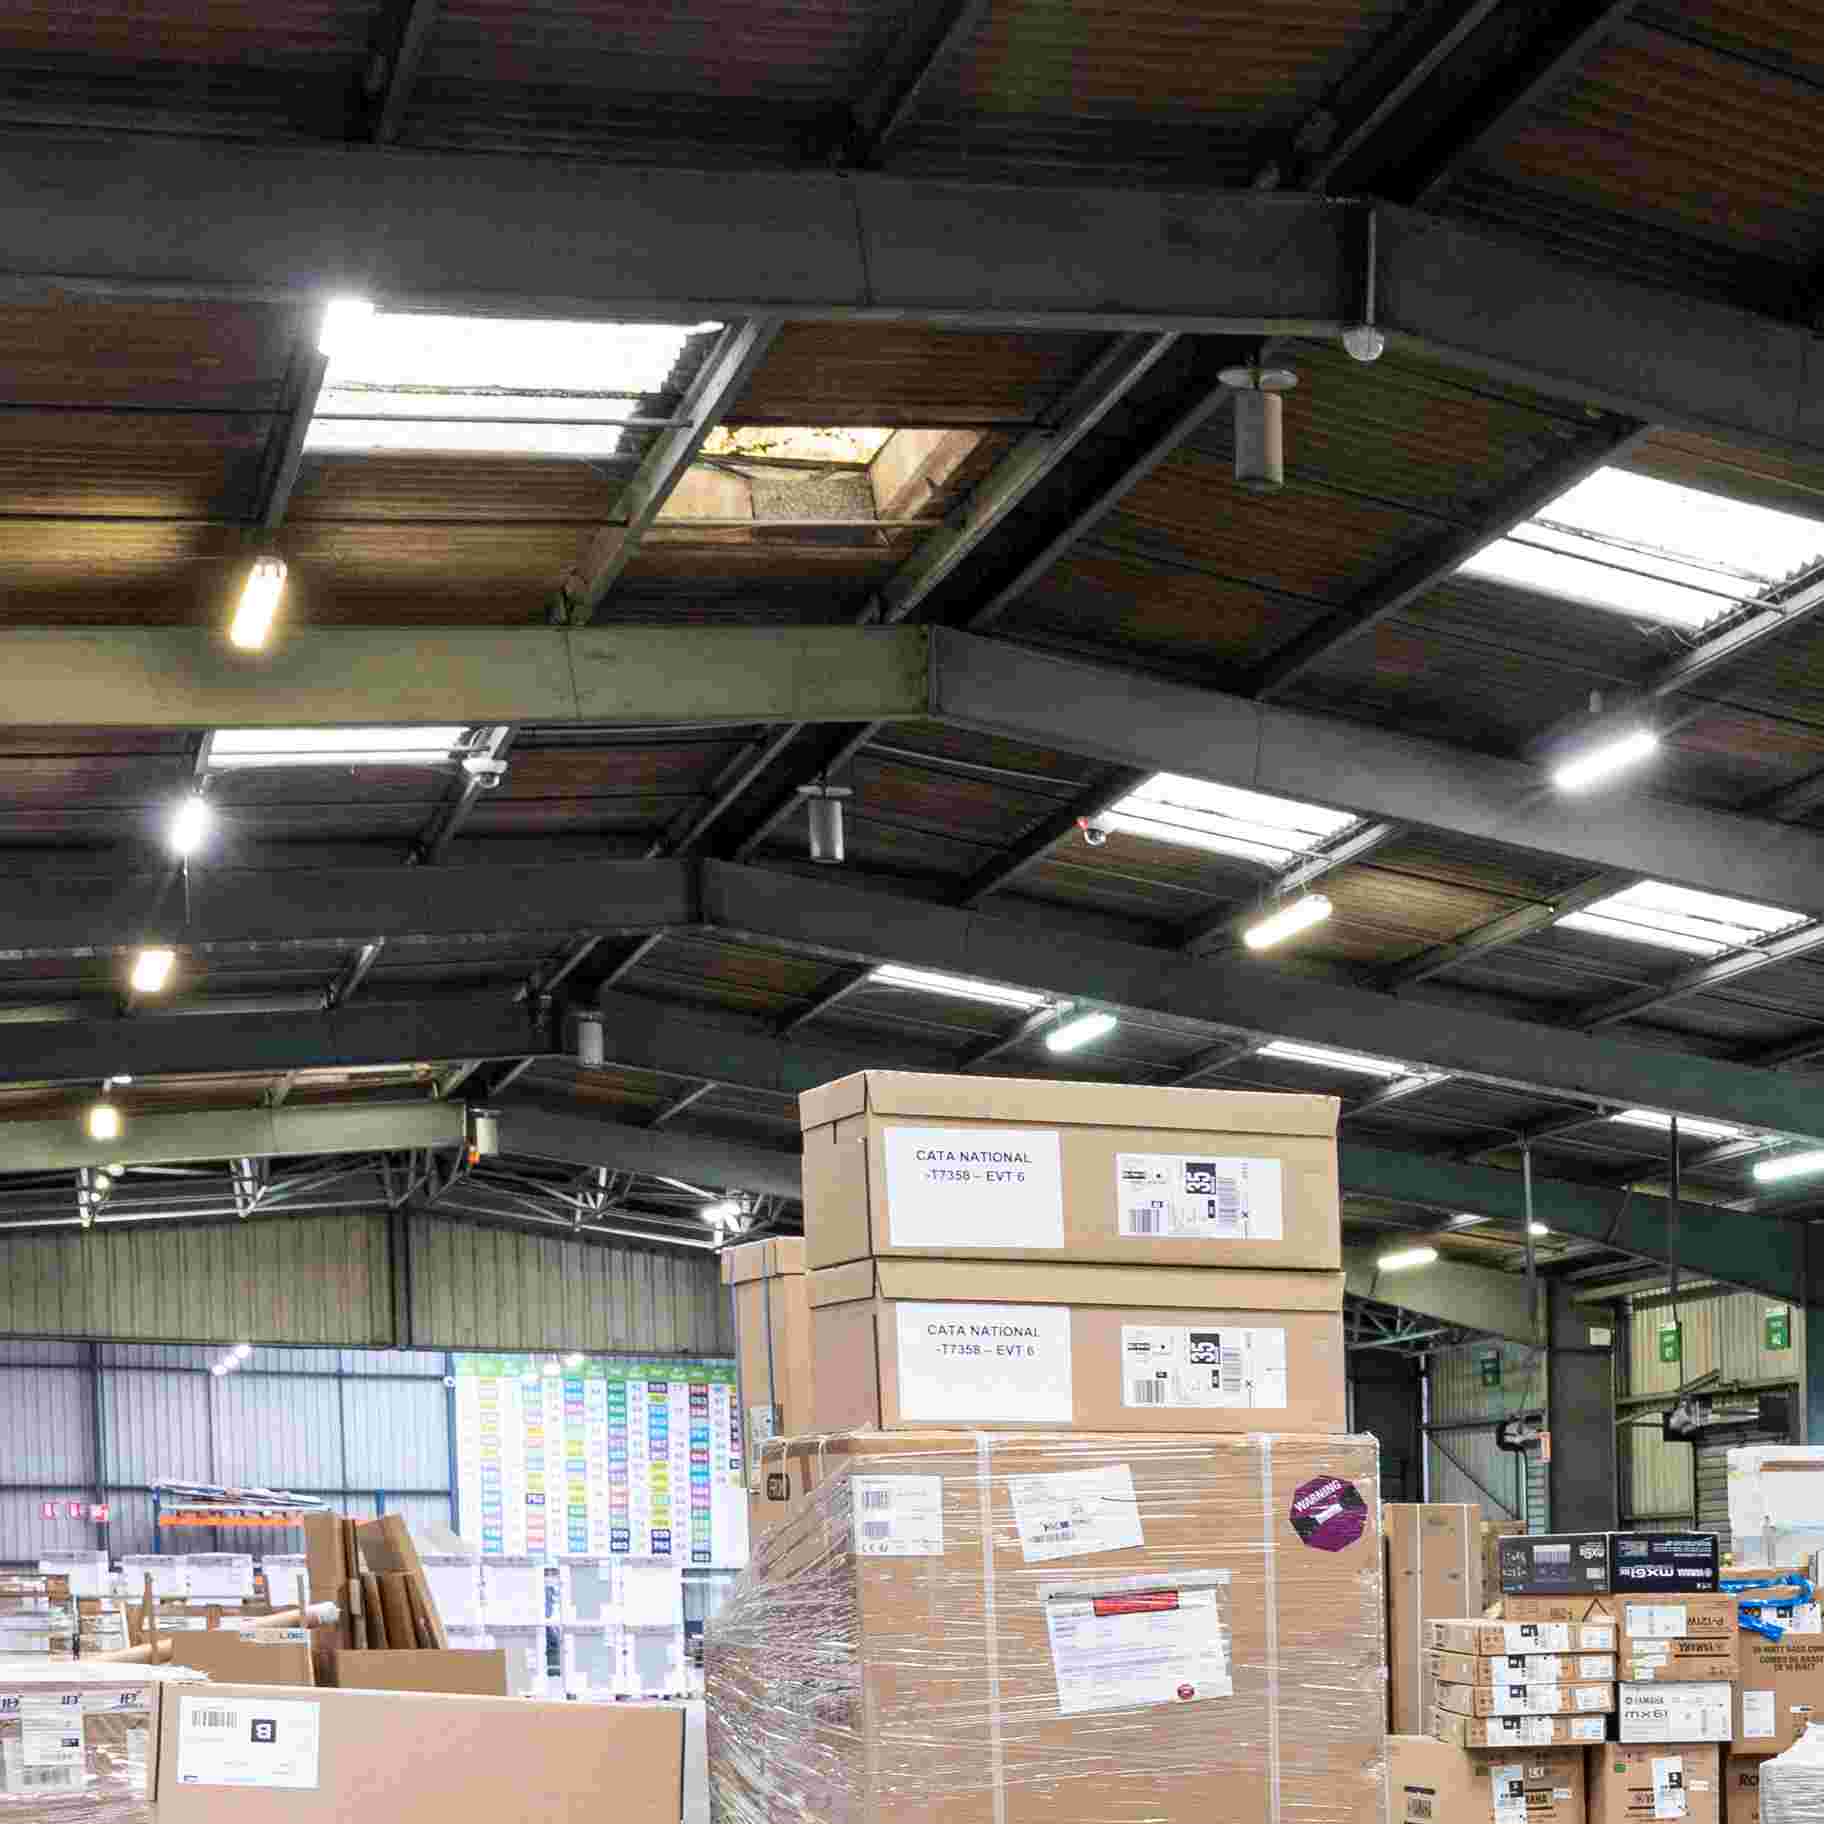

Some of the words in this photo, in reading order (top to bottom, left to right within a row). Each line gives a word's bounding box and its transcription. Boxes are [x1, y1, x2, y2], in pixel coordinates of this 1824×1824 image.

[915, 1149, 956, 1163] CATA
[959, 1151, 1033, 1165] NATIONAL
[986, 1170, 1014, 1183] EVT
[1016, 1171, 1026, 1183] 6
[926, 1323, 966, 1337] CATA
[970, 1324, 1041, 1338] NATIONAL
[996, 1344, 1024, 1357] EVT
[1026, 1344, 1036, 1357] 6
[1293, 1478, 1343, 1514] WARNING
